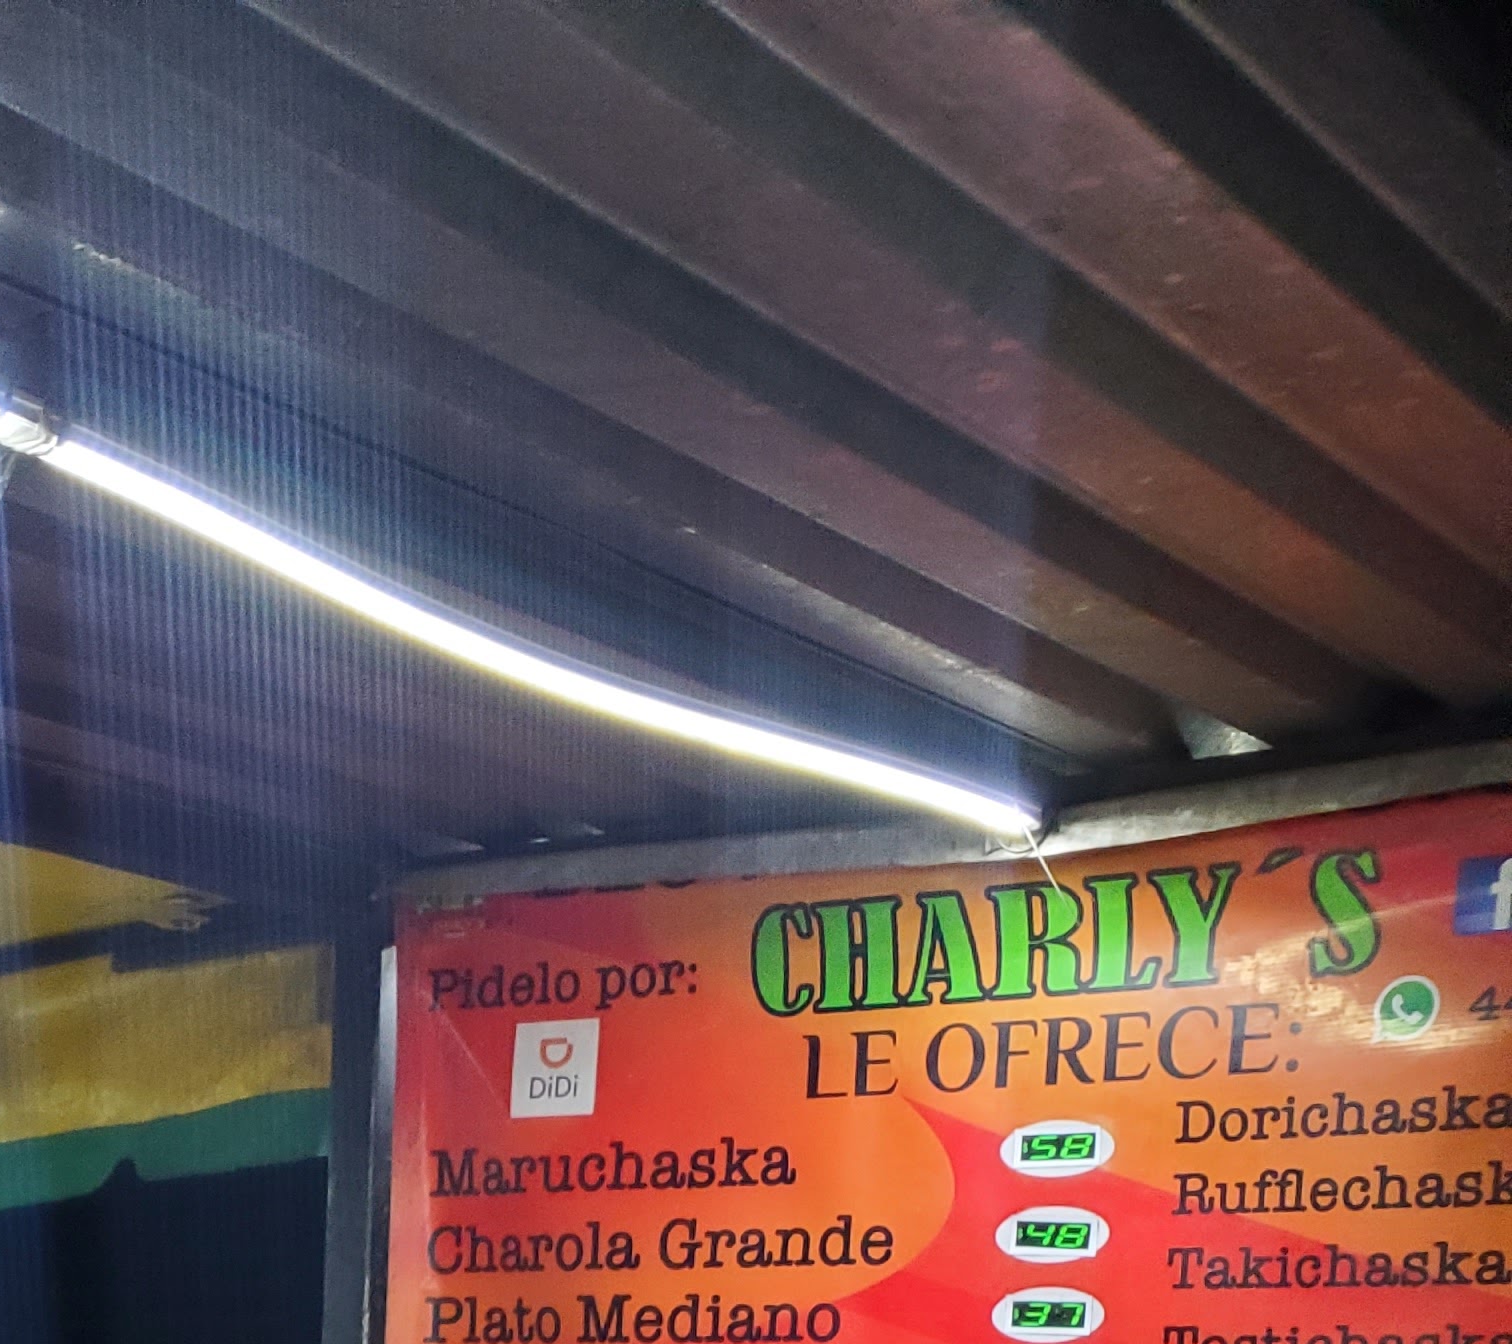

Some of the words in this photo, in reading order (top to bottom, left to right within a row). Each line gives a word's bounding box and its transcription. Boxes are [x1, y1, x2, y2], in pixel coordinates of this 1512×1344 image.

[428, 962, 580, 1011] Pidelo
[595, 959, 698, 1011] por:
[803, 1030, 899, 1100] LE
[925, 1003, 1300, 1093] OFRECE:
[530, 1075, 579, 1099] DiDi
[430, 1137, 796, 1197] Maruchaska
[427, 1222, 640, 1273] Charola
[659, 1215, 893, 1267] Grande
[1167, 1239, 1512, 1290] Takichaska
[423, 1296, 561, 1344] Plato
[576, 1294, 842, 1343] Mediano
